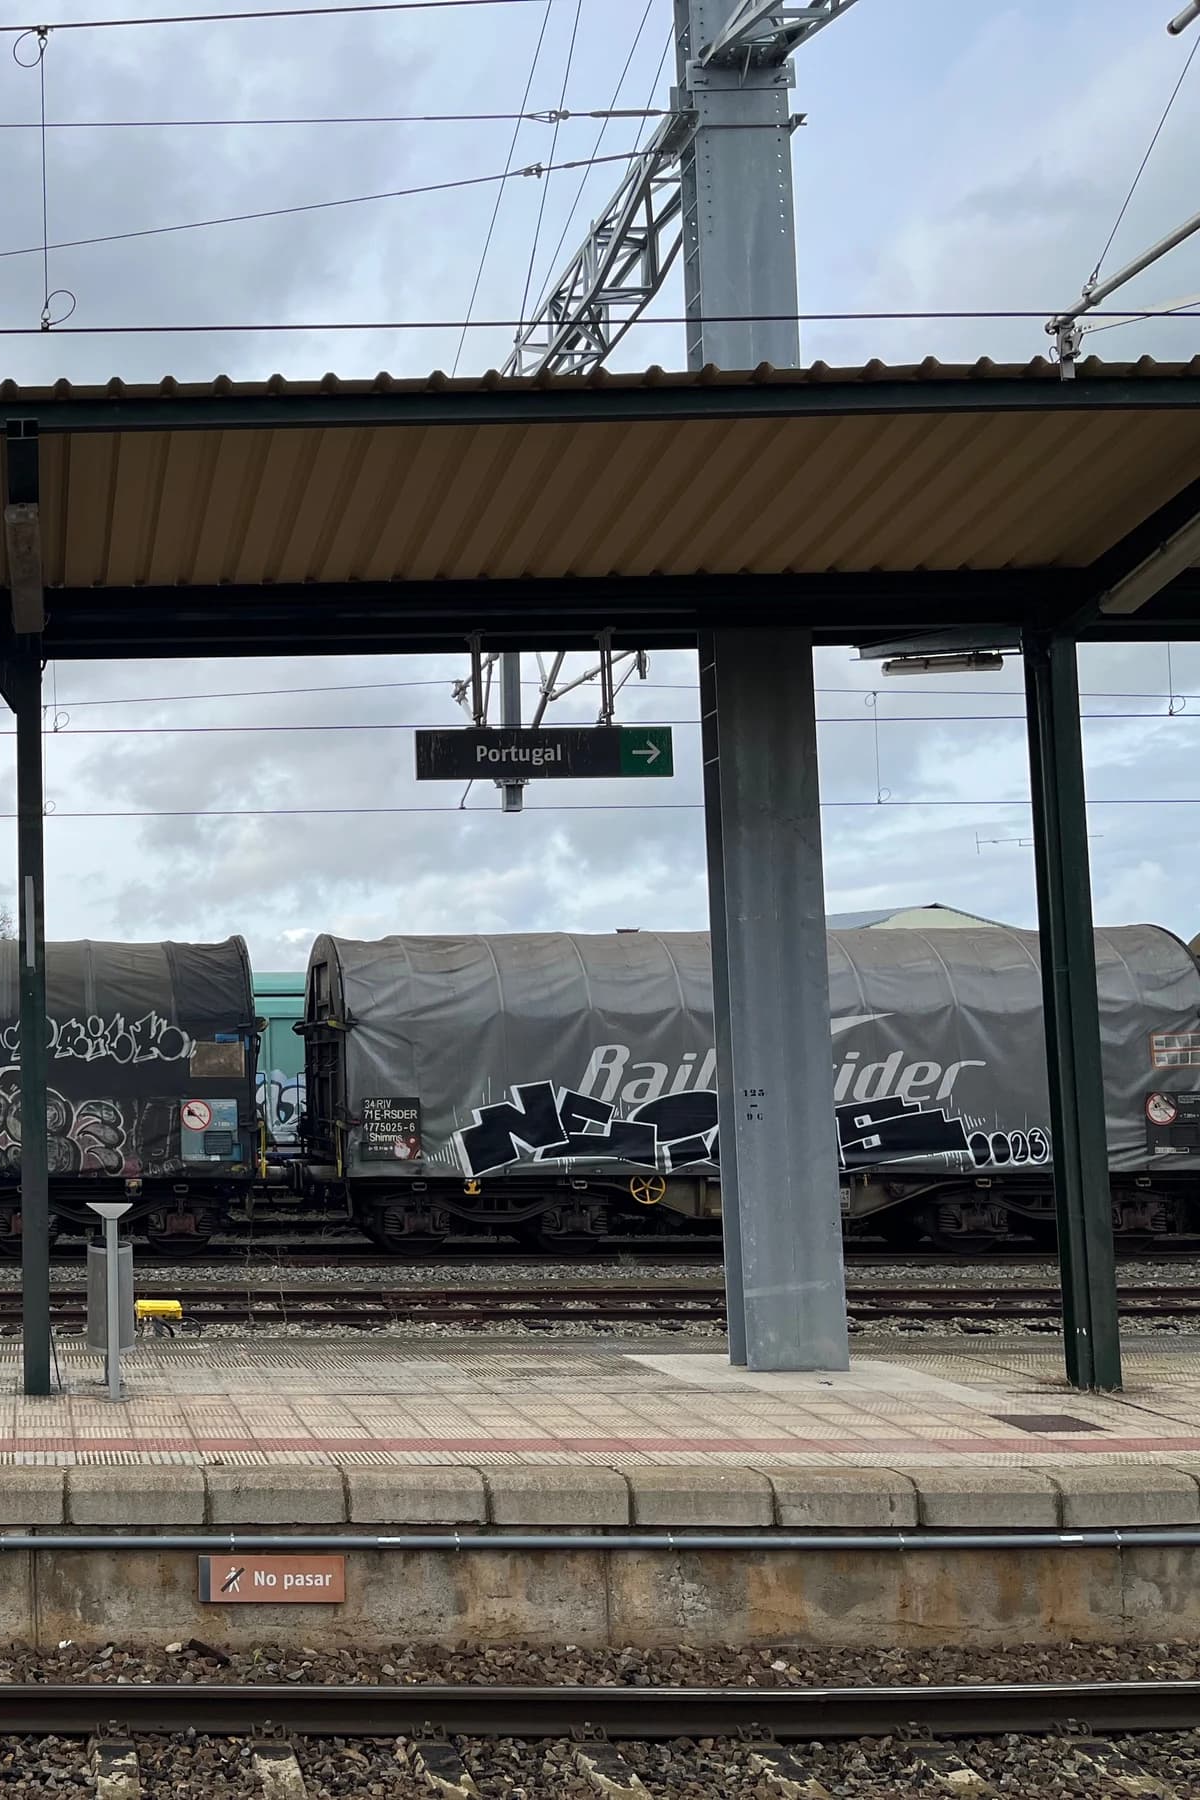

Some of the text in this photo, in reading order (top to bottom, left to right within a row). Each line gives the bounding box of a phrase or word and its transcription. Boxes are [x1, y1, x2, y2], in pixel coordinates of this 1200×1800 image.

[476, 744, 562, 766] Portugal
[254, 1570, 333, 1590] No pasar
